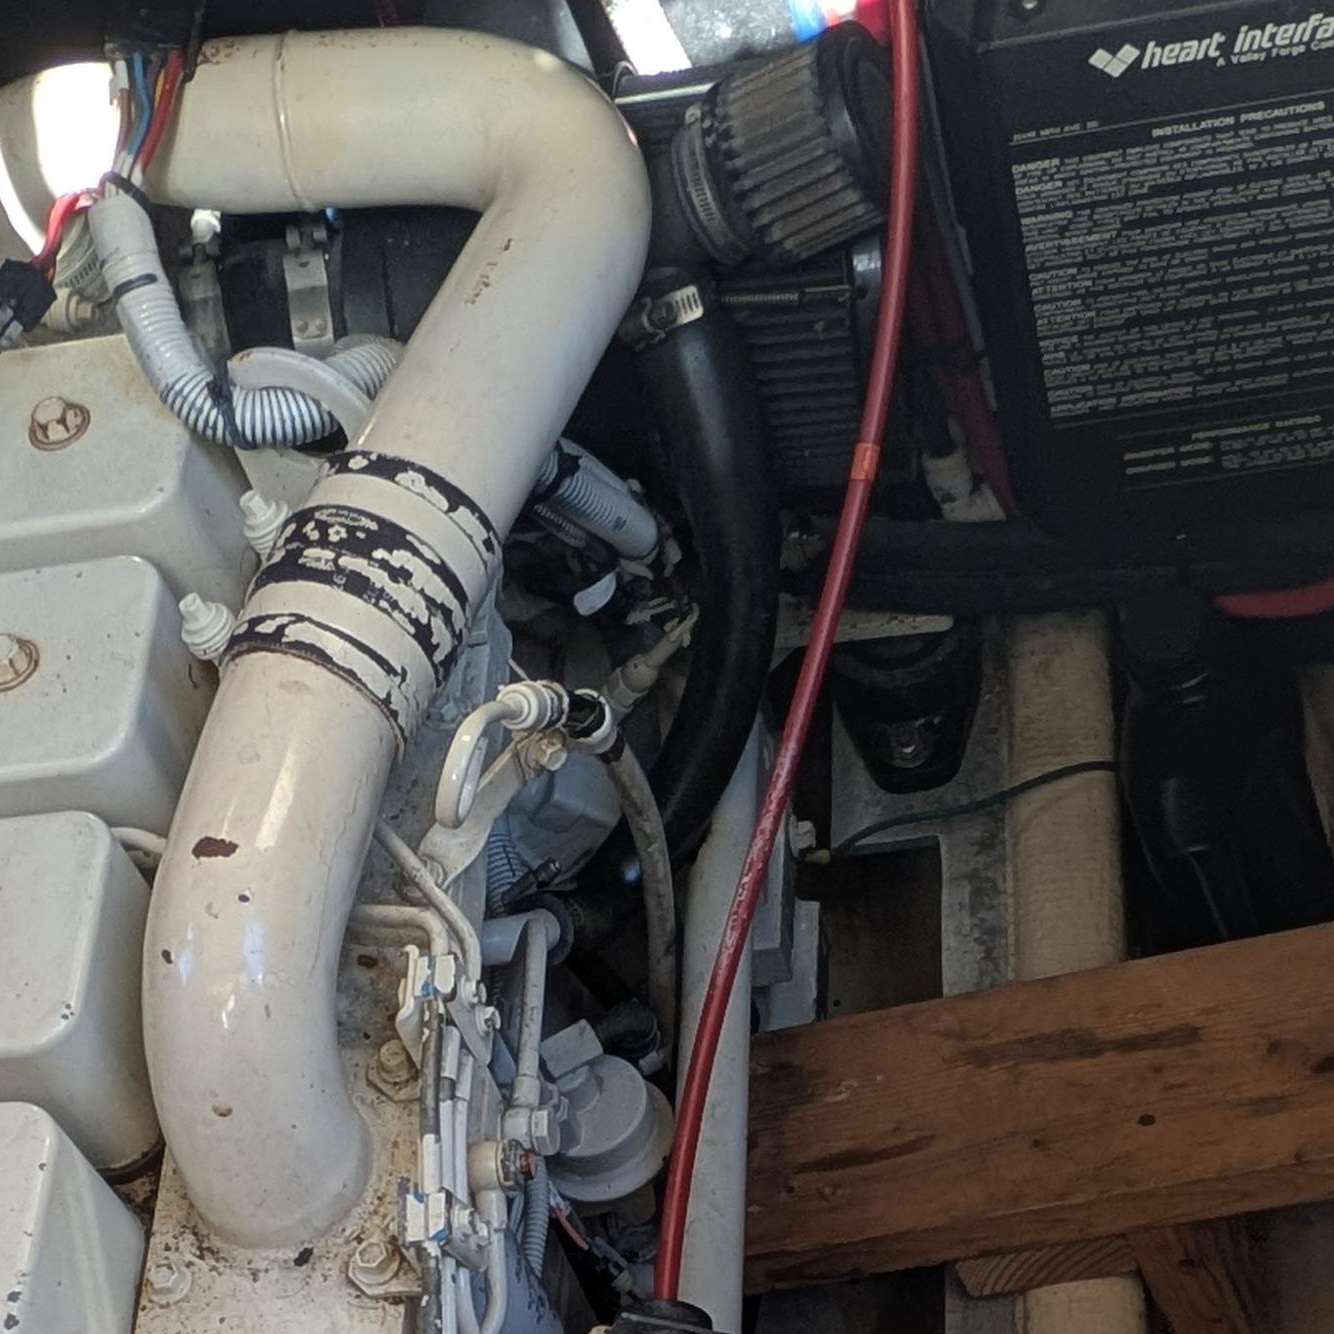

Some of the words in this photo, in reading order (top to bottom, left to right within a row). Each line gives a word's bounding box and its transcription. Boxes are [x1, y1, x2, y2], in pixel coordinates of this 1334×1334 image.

[1141, 32, 1226, 69] heart
[1216, 54, 1226, 67] A
[1231, 51, 1266, 65] Valley
[1271, 45, 1306, 58] Forge
[1152, 115, 1234, 138] INSTALLATION
[1239, 100, 1325, 123] PRECAUTIONS
[1011, 158, 1060, 173] DANGER
[1015, 180, 1063, 195] DANGER
